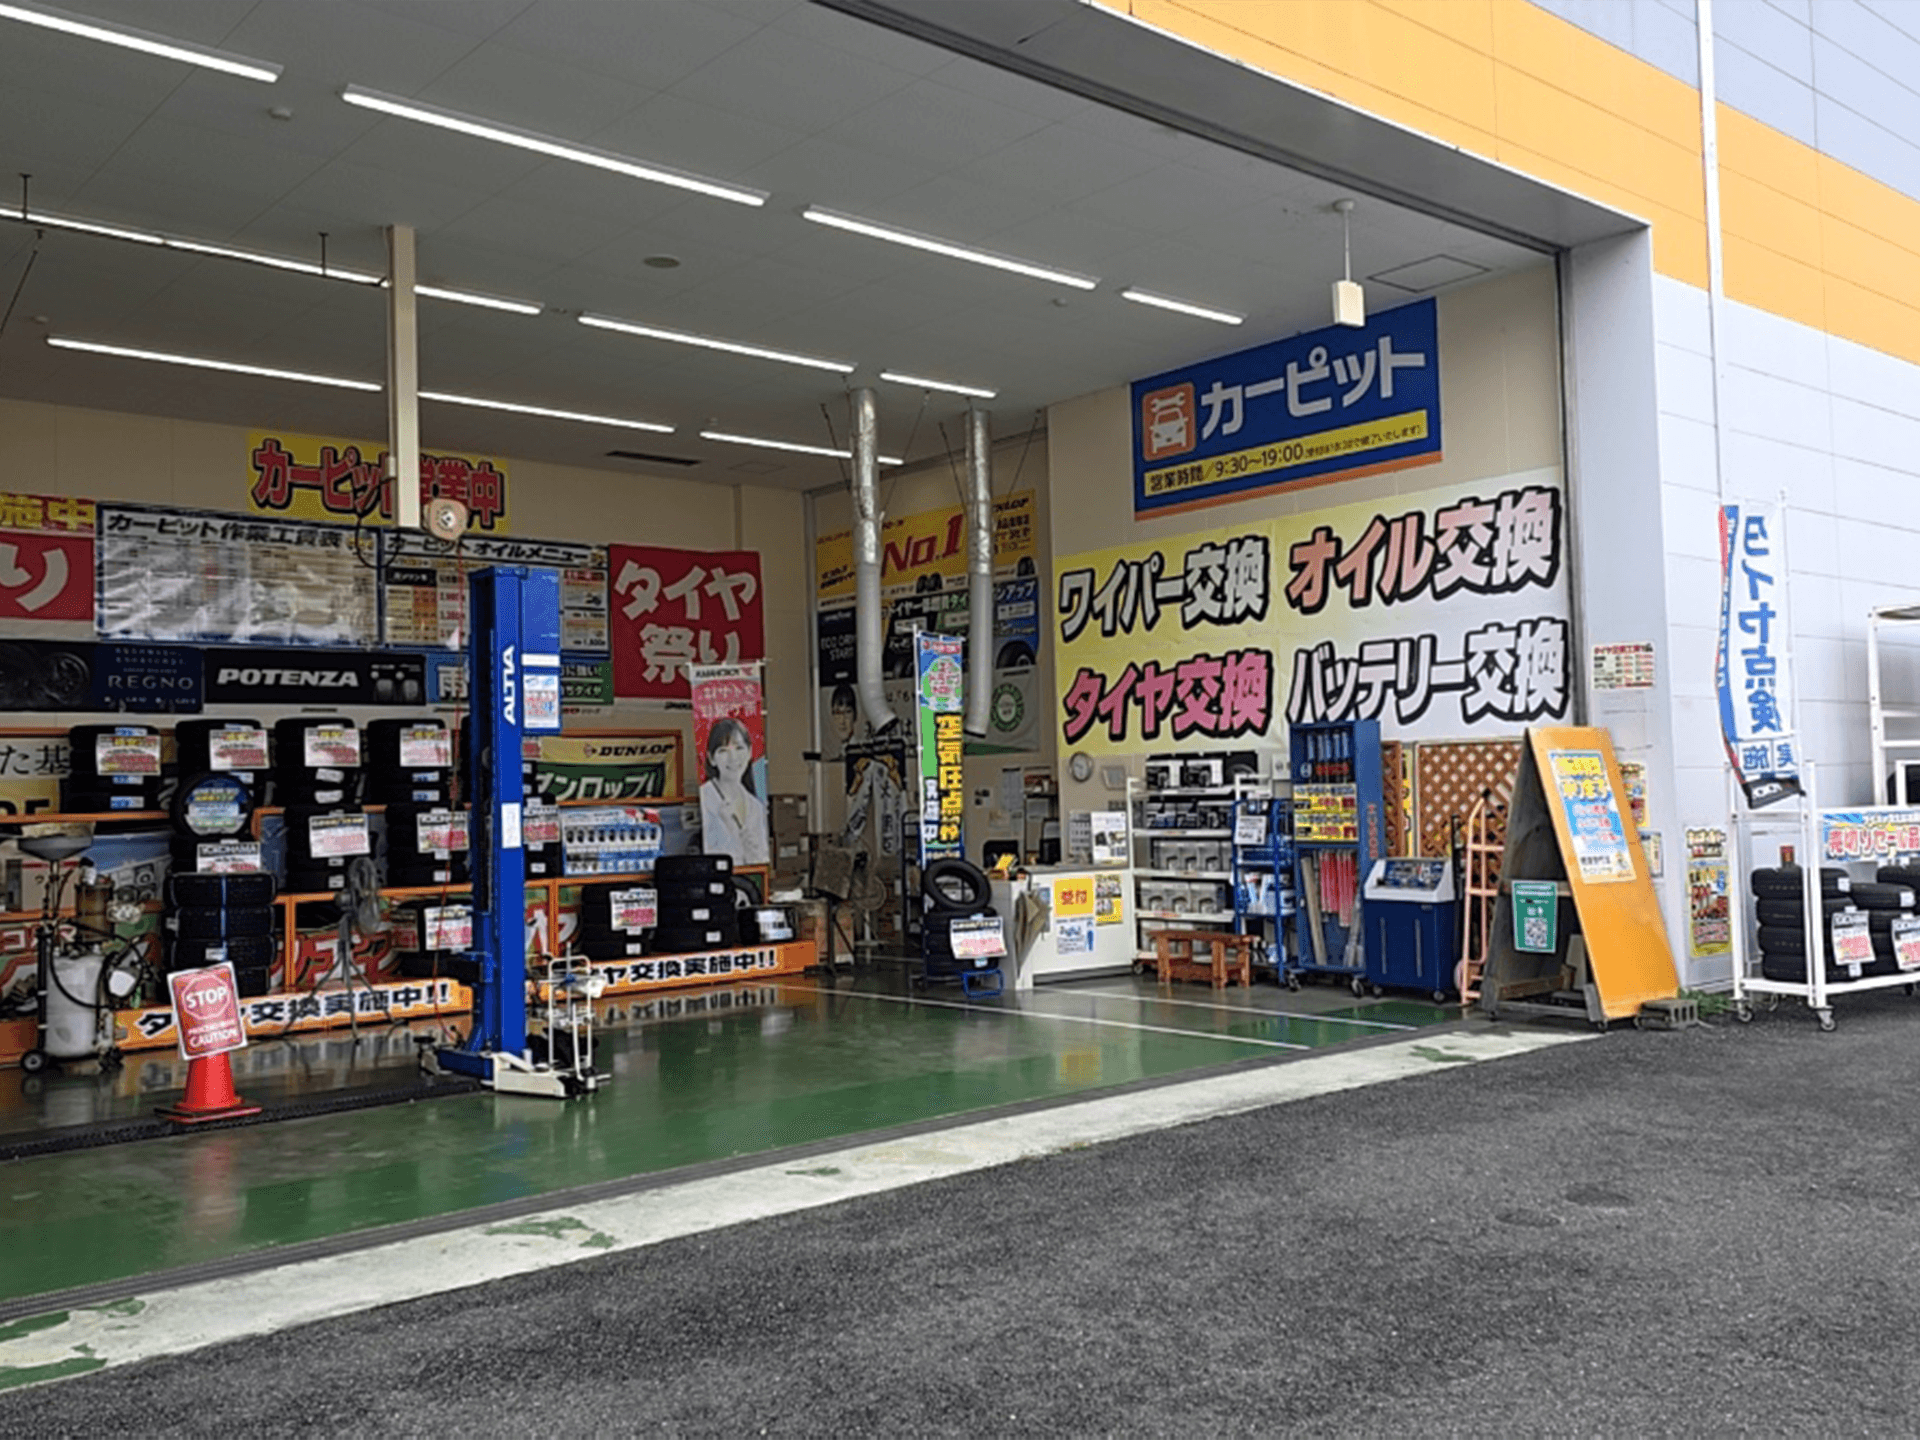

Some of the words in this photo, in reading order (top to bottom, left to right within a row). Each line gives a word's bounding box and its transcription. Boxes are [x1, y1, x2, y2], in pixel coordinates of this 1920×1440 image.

[1201, 336, 1425, 440] カーピット
[1287, 487, 1561, 614] オイル交換
[614, 561, 756, 620] タイヤ
[1060, 536, 1269, 642] ワイパー交換
[107, 674, 194, 691] REGNO
[217, 668, 359, 687] POTENZA
[639, 623, 742, 684] 祭り
[1288, 617, 1569, 724] バッテリー交換
[503, 645, 516, 725] ALTIA
[1063, 649, 1273, 745] タイヤ交換
[599, 744, 676, 757] DUNLOP
[591, 950, 775, 984] ヤ交換実施中!!
[138, 983, 448, 1036] タ交換実施中!!
[186, 986, 227, 1009] STOP
